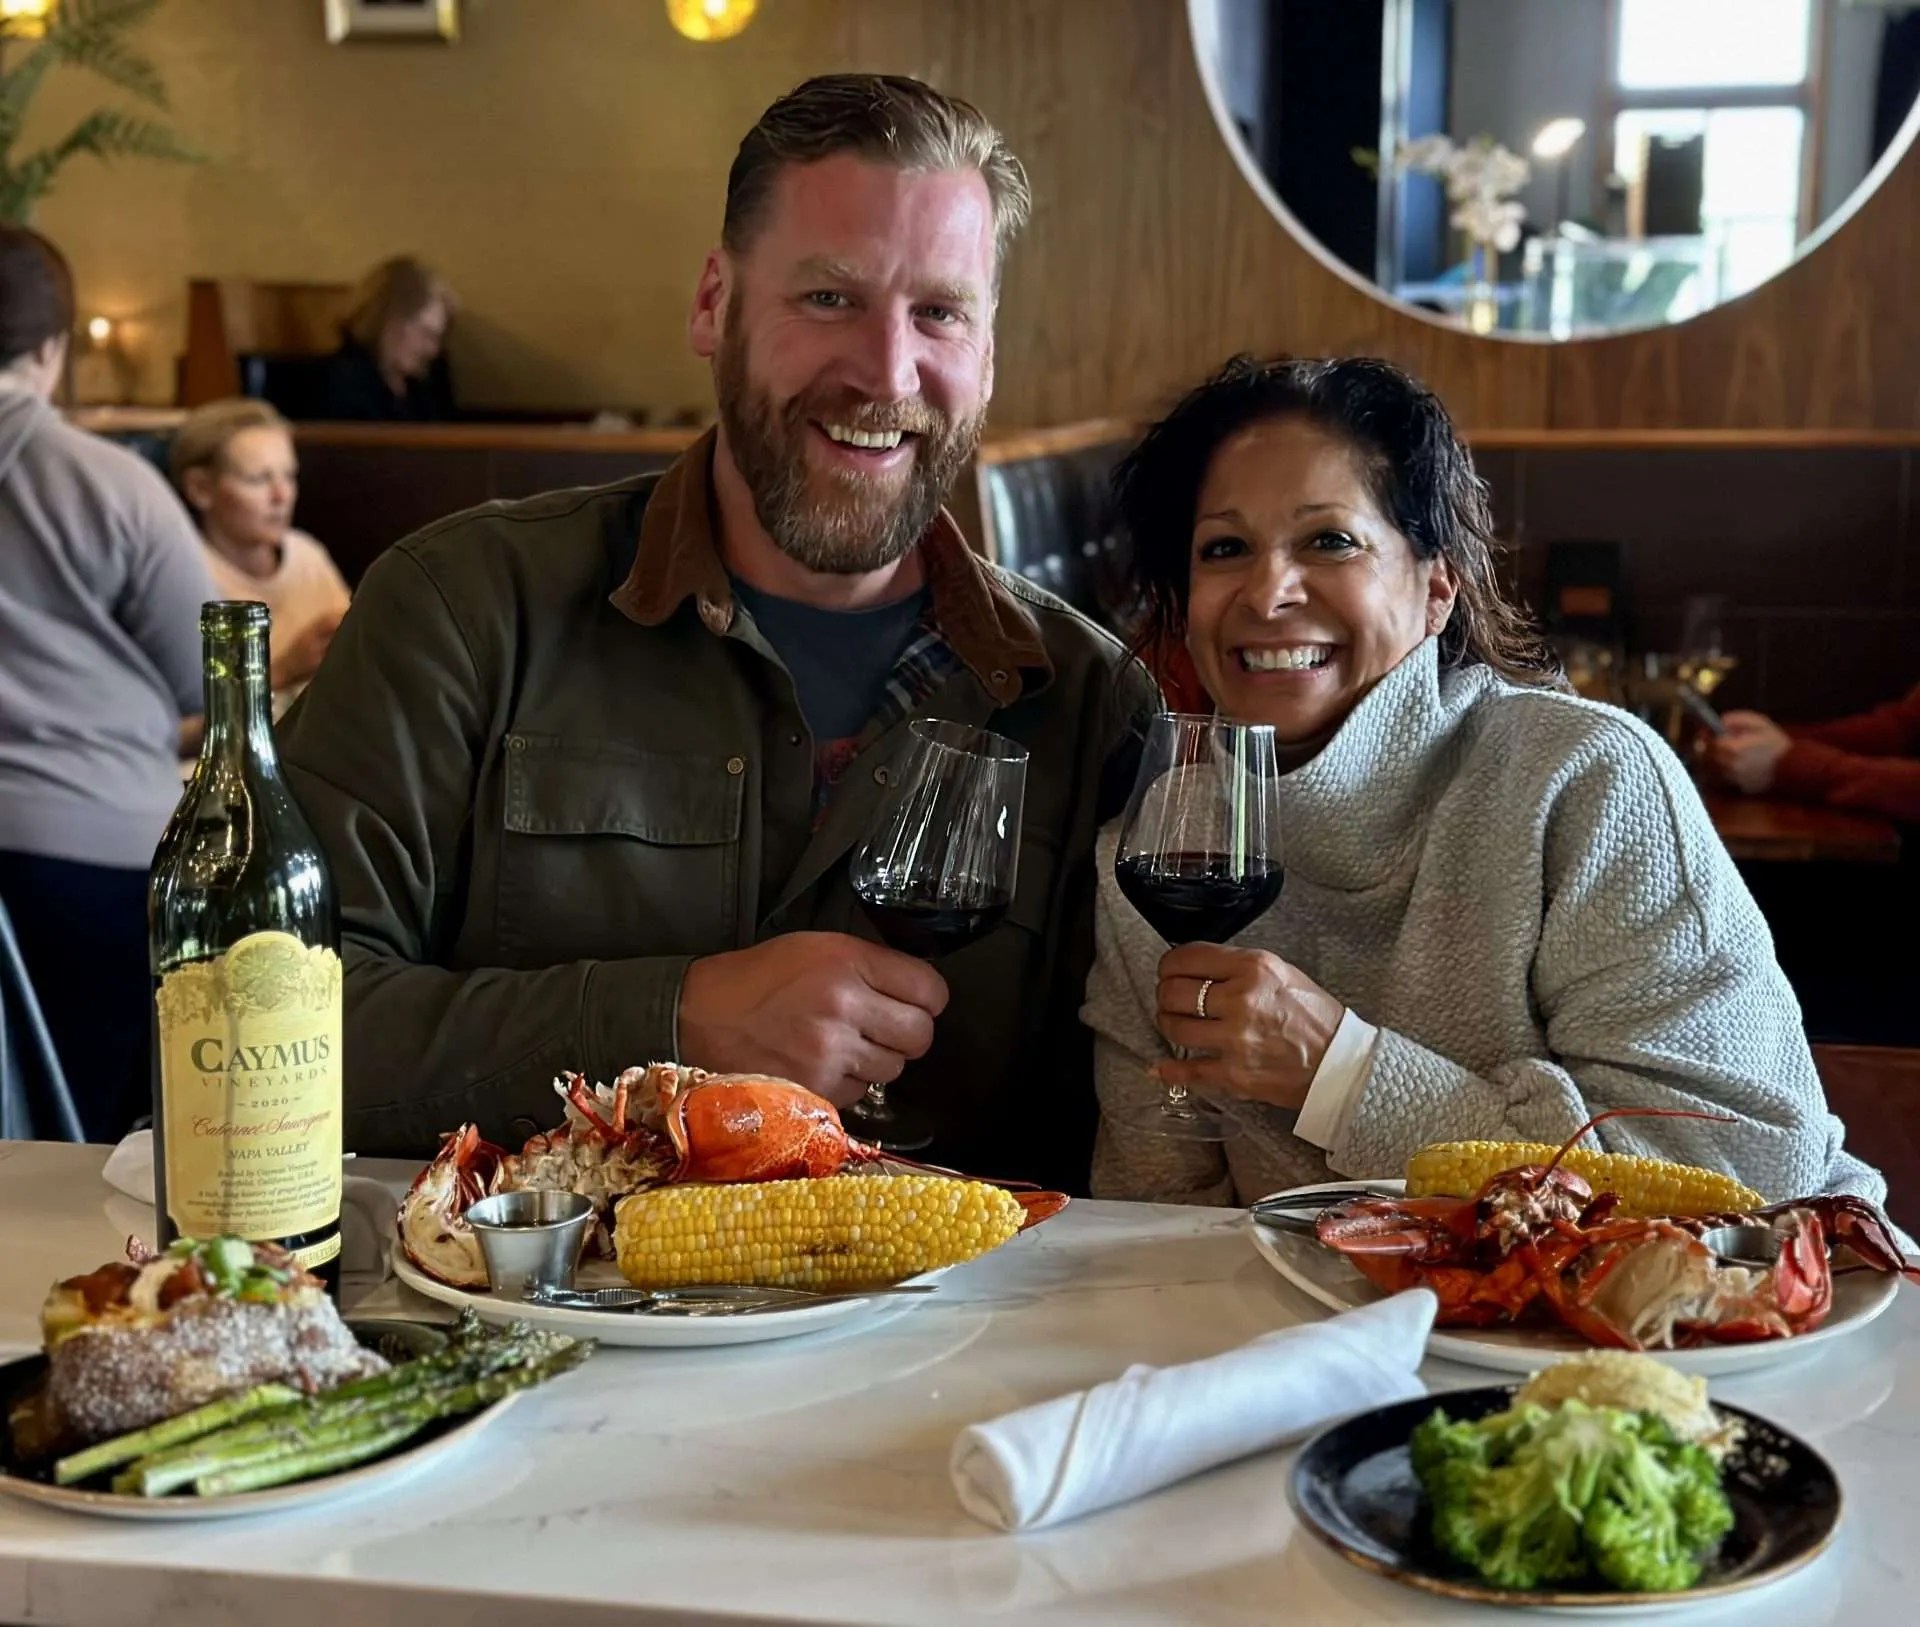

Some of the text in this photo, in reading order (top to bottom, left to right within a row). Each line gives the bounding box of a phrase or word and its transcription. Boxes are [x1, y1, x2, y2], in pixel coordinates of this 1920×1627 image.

[190, 1034, 330, 1073] CAYMUS
[201, 1066, 328, 1088] VINEYARDS
[251, 1097, 289, 1108] 2020
[191, 1114, 264, 1137] Cabernet
[229, 1140, 310, 1160] NAPA VALLEY
